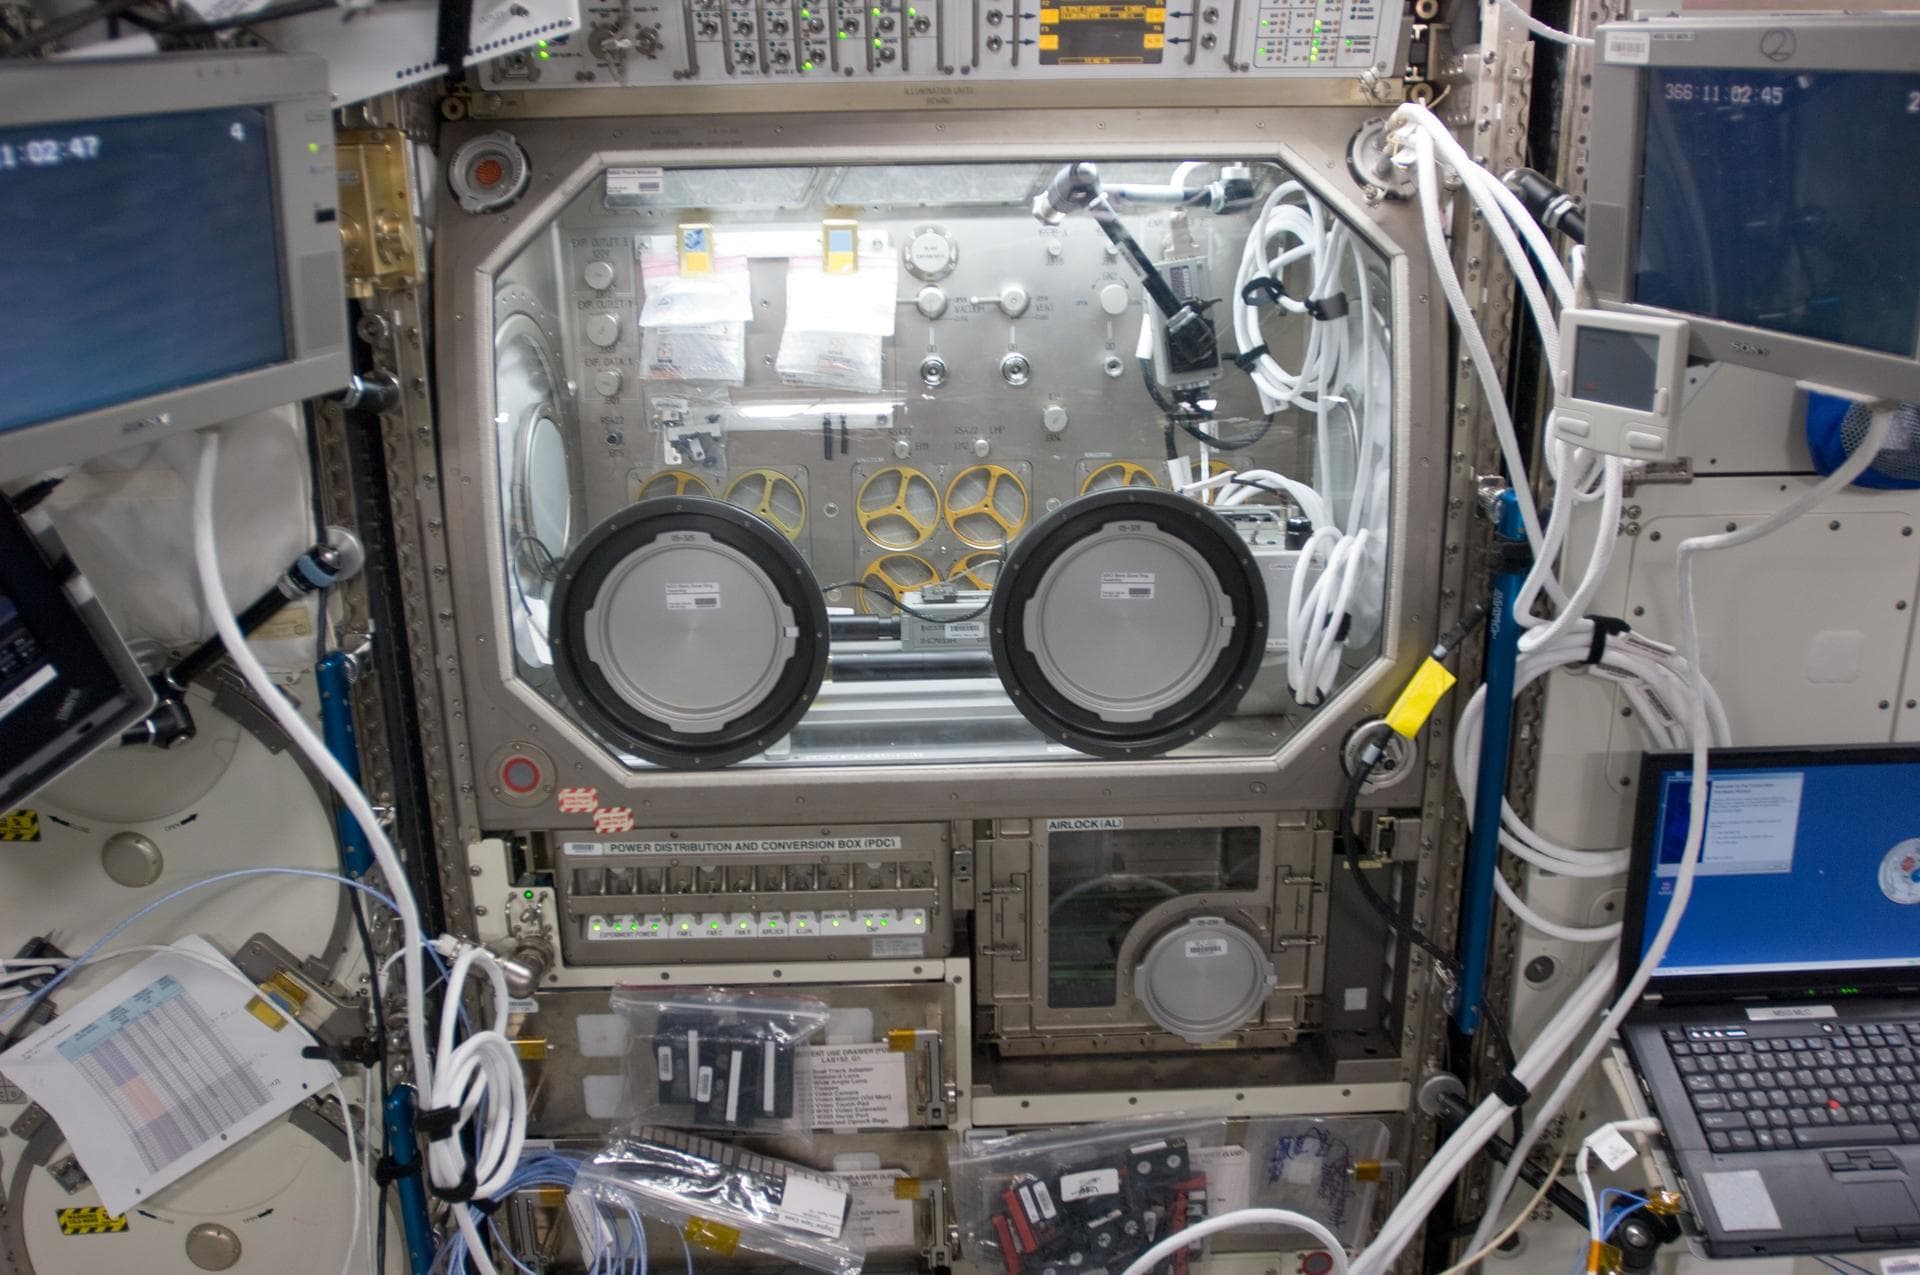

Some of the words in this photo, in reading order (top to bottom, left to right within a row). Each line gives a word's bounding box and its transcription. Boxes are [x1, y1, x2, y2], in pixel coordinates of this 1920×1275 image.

[1664, 83, 1784, 104] 366:11:02:45
[229, 122, 245, 141] 4
[610, 843, 651, 853] POWER
[655, 842, 732, 853] DISTRIBUTION
[735, 842, 759, 851] AND
[762, 840, 836, 851] CONVERSION
[838, 839, 862, 849] BOX
[864, 838, 896, 849] (PDC)
[842, 1048, 874, 1056] DRAWER
